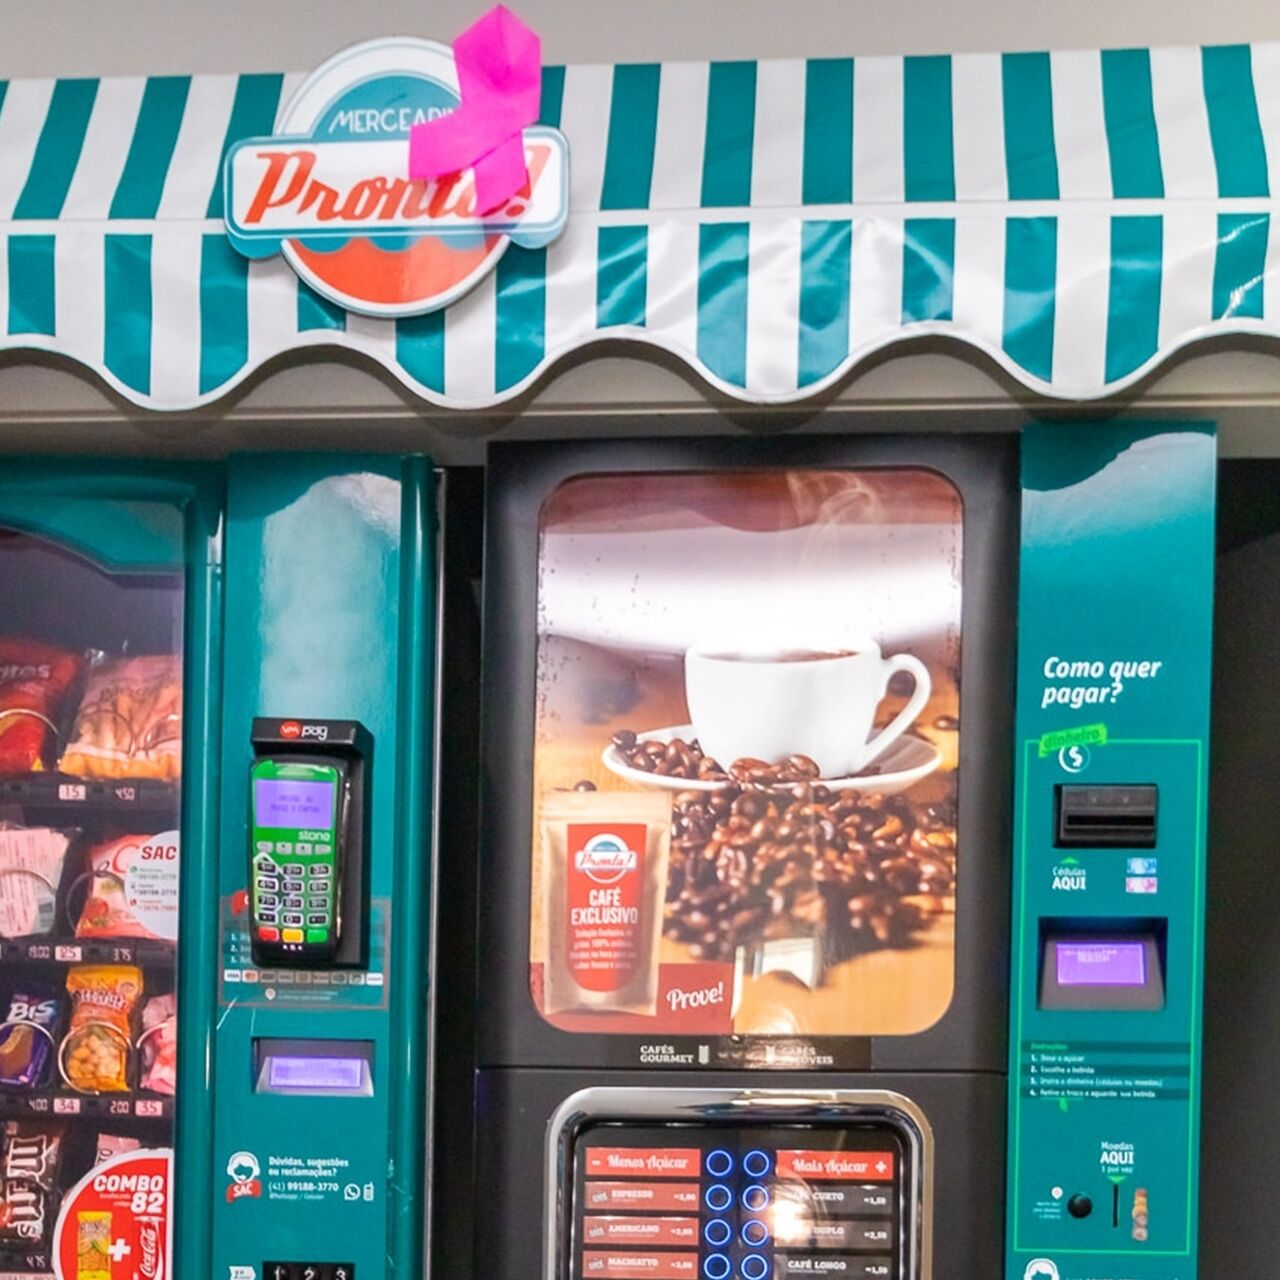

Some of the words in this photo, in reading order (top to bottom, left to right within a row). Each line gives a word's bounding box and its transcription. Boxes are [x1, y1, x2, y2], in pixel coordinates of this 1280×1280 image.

[1044, 656, 1104, 679] Como
[1109, 660, 1162, 683] quer
[1041, 682, 1123, 709] pagar?
[1043, 728, 1101, 749] dinheiro
[298, 830, 331, 842] stone
[141, 845, 178, 861] SAC
[1052, 876, 1087, 891] AQUI
[588, 886, 622, 906] CAFÉ
[570, 907, 639, 925] EXCLUSIVO
[666, 981, 724, 1011] Prove!
[639, 1043, 674, 1054] CAFÉS
[639, 1053, 695, 1064] GOURMET
[1101, 1141, 1135, 1150] Moedas
[268, 1156, 305, 1168] Dúvidas,
[307, 1157, 349, 1169] sugestões
[607, 1154, 645, 1169] Menos
[1100, 1151, 1135, 1165] AQUI
[268, 1168, 279, 1176] ou
[281, 1167, 338, 1178] reclamações?
[792, 1159, 823, 1173] Mais
[93, 1175, 164, 1192] COMBO
[233, 1183, 253, 1198] SAC
[268, 1182, 286, 1192] (41)
[287, 1181, 340, 1192] 99188-3770
[130, 1192, 165, 1214] 82
[813, 1192, 845, 1202] CURTO
[787, 1260, 812, 1270] CAFÉ
[814, 1261, 847, 1271] LONGO
